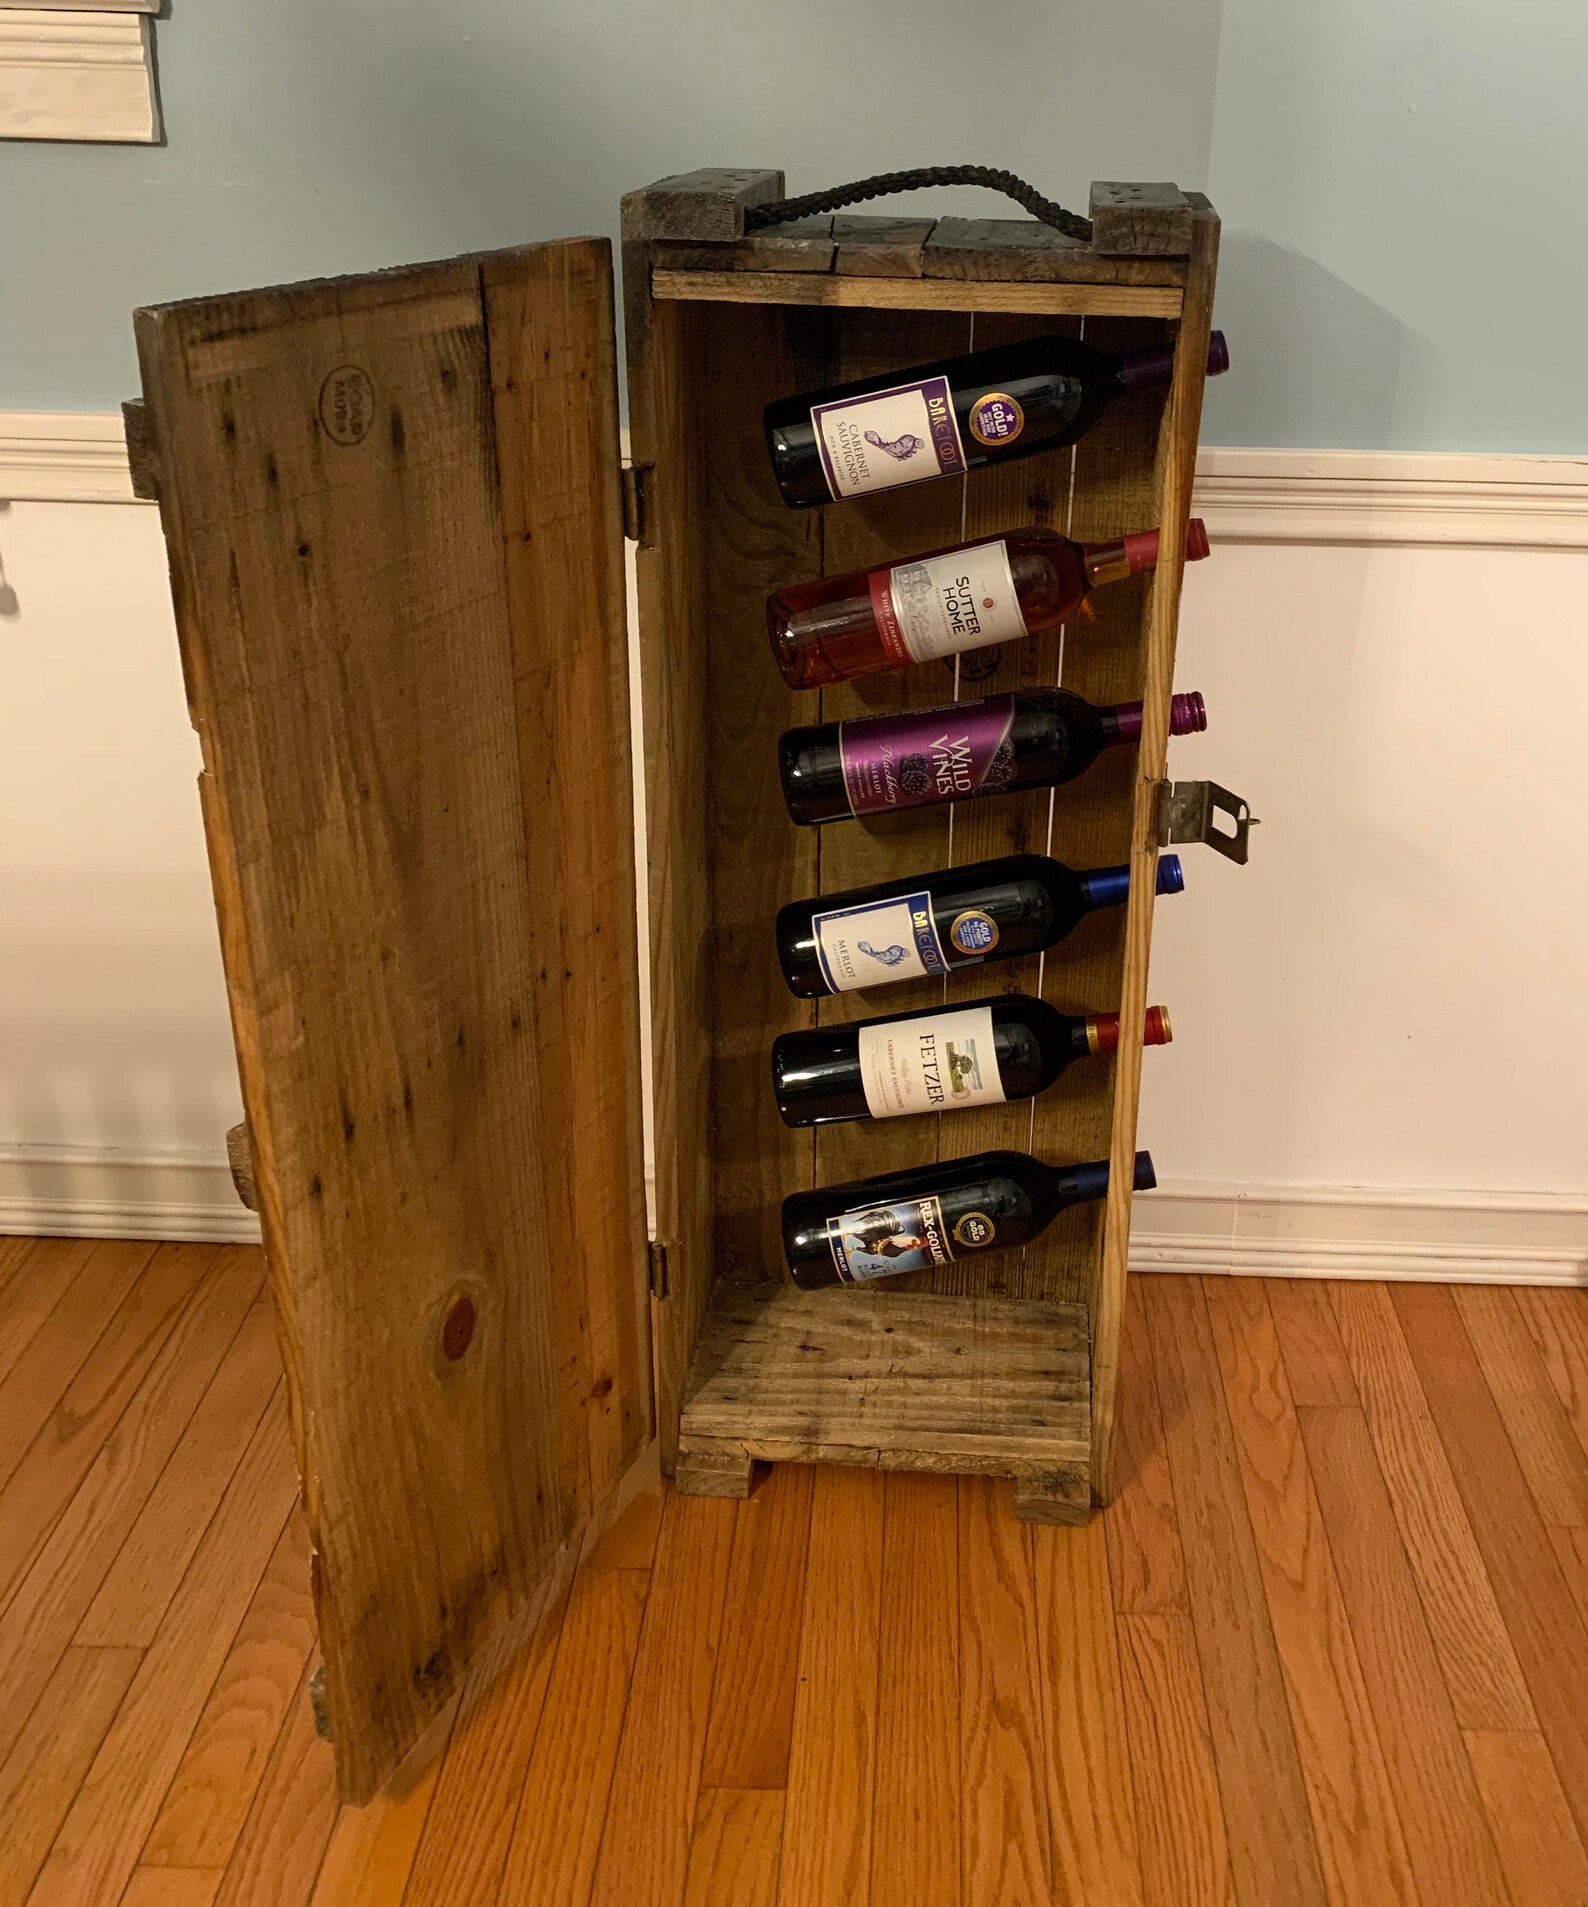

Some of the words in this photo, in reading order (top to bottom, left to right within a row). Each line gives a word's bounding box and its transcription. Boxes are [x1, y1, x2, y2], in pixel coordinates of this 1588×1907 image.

[991, 402, 1008, 438] GOLD!
[836, 421, 861, 486] SAUVIGNON
[849, 423, 871, 480] CABERNET
[880, 589, 890, 618] WHITE
[942, 587, 966, 635] HOME
[955, 576, 981, 636] SUTTER
[870, 762, 882, 794] MERLOT
[879, 743, 901, 805] Blackberry
[929, 734, 955, 795] VINES
[948, 735, 973, 792] WILD
[979, 921, 991, 943] GOLD
[838, 939, 857, 980] MERLOT
[886, 1039, 897, 1076] CABERNET
[919, 1033, 945, 1105] FETZER
[969, 1221, 980, 1242] GOLD
[835, 1246, 848, 1273] MERLOT
[870, 1262, 887, 1276] 47
